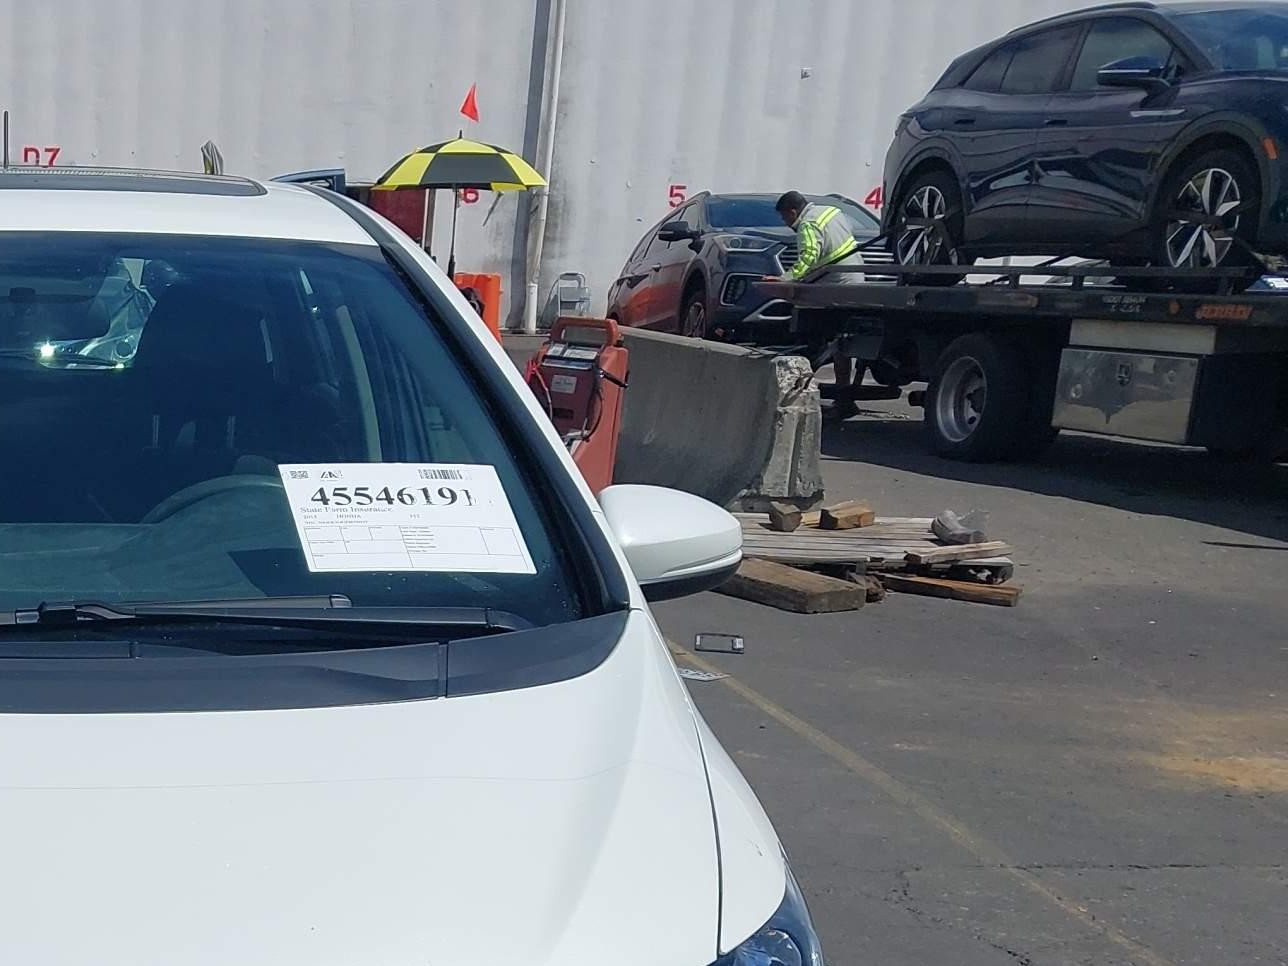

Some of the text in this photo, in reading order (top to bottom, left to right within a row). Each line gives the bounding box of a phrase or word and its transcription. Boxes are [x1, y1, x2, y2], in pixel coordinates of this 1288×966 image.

[464, 187, 480, 204] 6
[669, 185, 687, 208] 5
[864, 186, 883, 209] 4
[311, 486, 475, 507] 45546191
